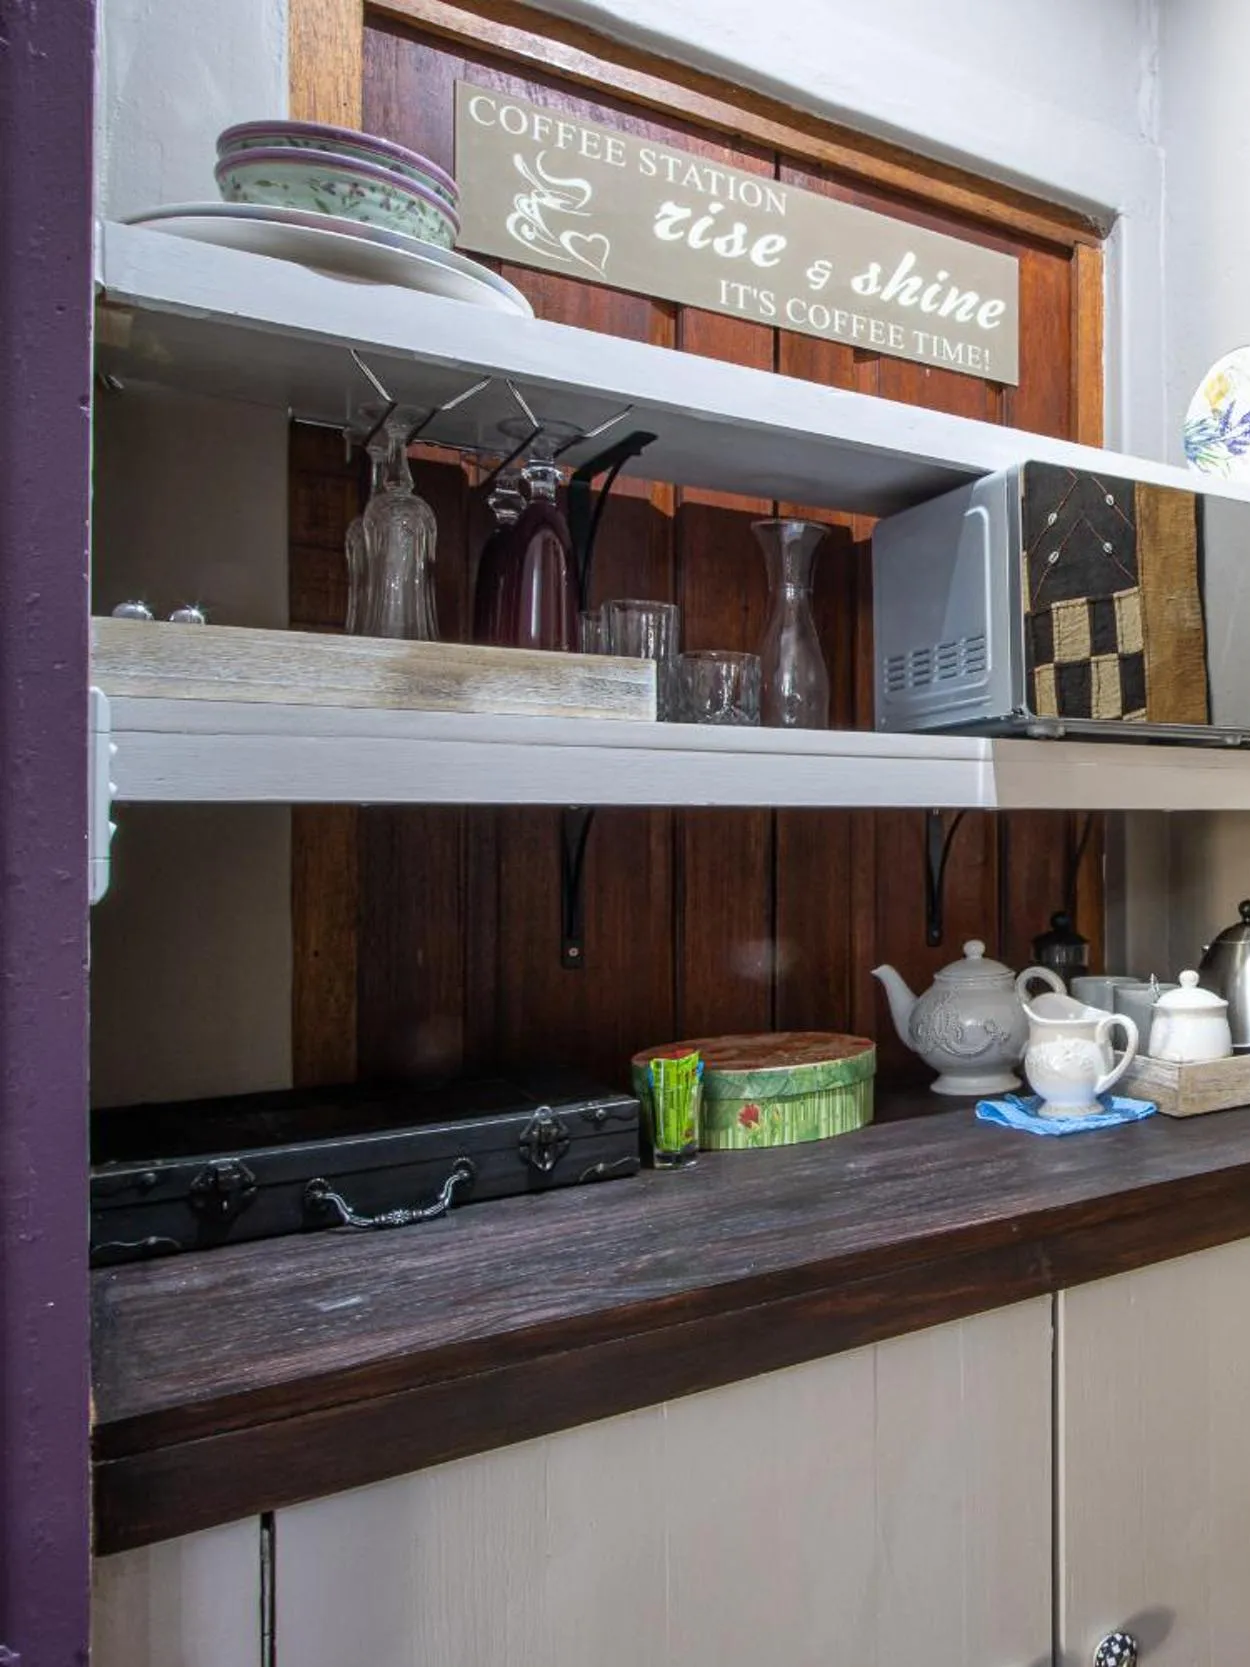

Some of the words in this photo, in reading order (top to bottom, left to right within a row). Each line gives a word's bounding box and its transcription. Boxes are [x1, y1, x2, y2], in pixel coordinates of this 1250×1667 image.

[468, 95, 627, 168] COFFEE
[638, 147, 788, 217] STATION
[652, 199, 788, 269] rise
[805, 259, 833, 291] &
[850, 250, 1006, 330] shine
[719, 279, 777, 317] IT'S
[784, 298, 906, 350] COFFEE
[912, 329, 991, 372] TIME!
